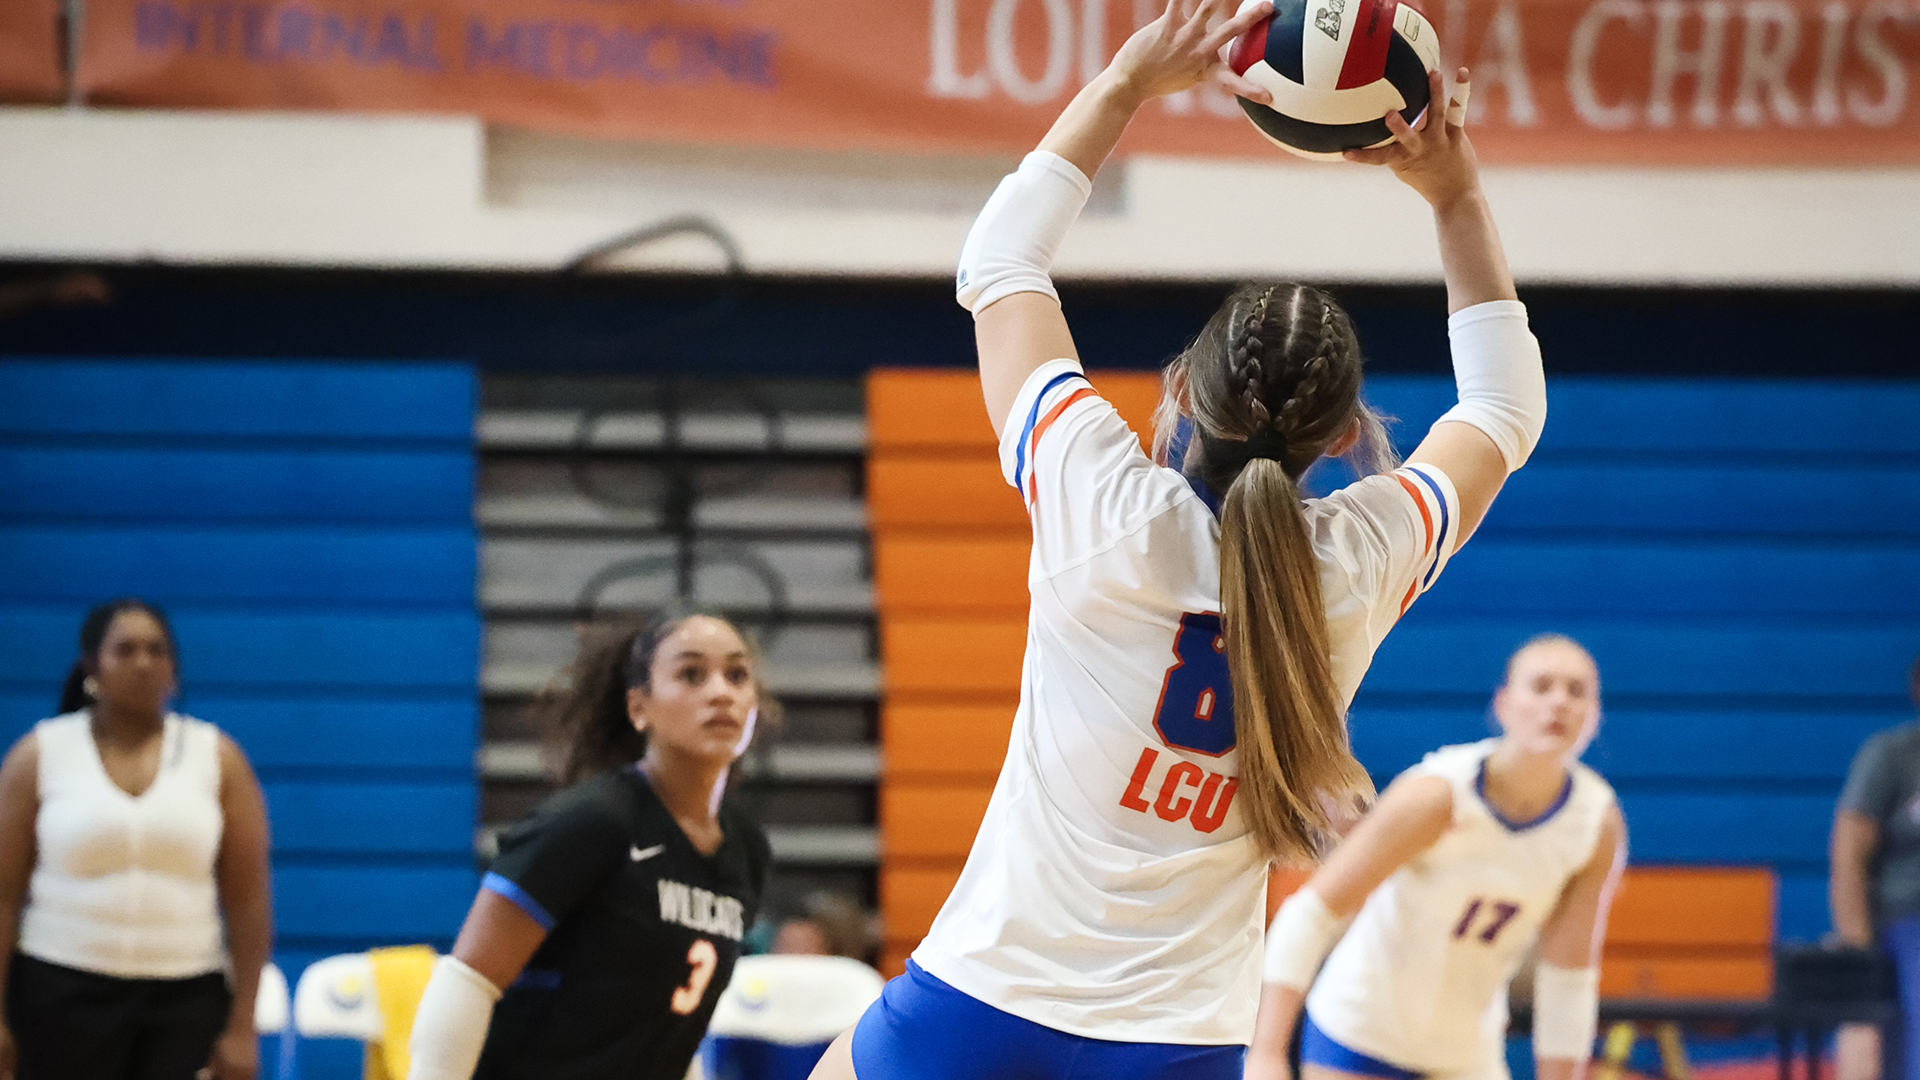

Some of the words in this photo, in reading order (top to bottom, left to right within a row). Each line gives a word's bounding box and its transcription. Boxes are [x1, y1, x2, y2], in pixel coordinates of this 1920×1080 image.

[134, 2, 442, 71] INTERNAL
[463, 16, 784, 89] MEDICINE
[1152, 610, 1238, 758] 8
[1119, 747, 1238, 834] LCU
[1453, 898, 1521, 943] 17
[670, 938, 718, 1016] 3
